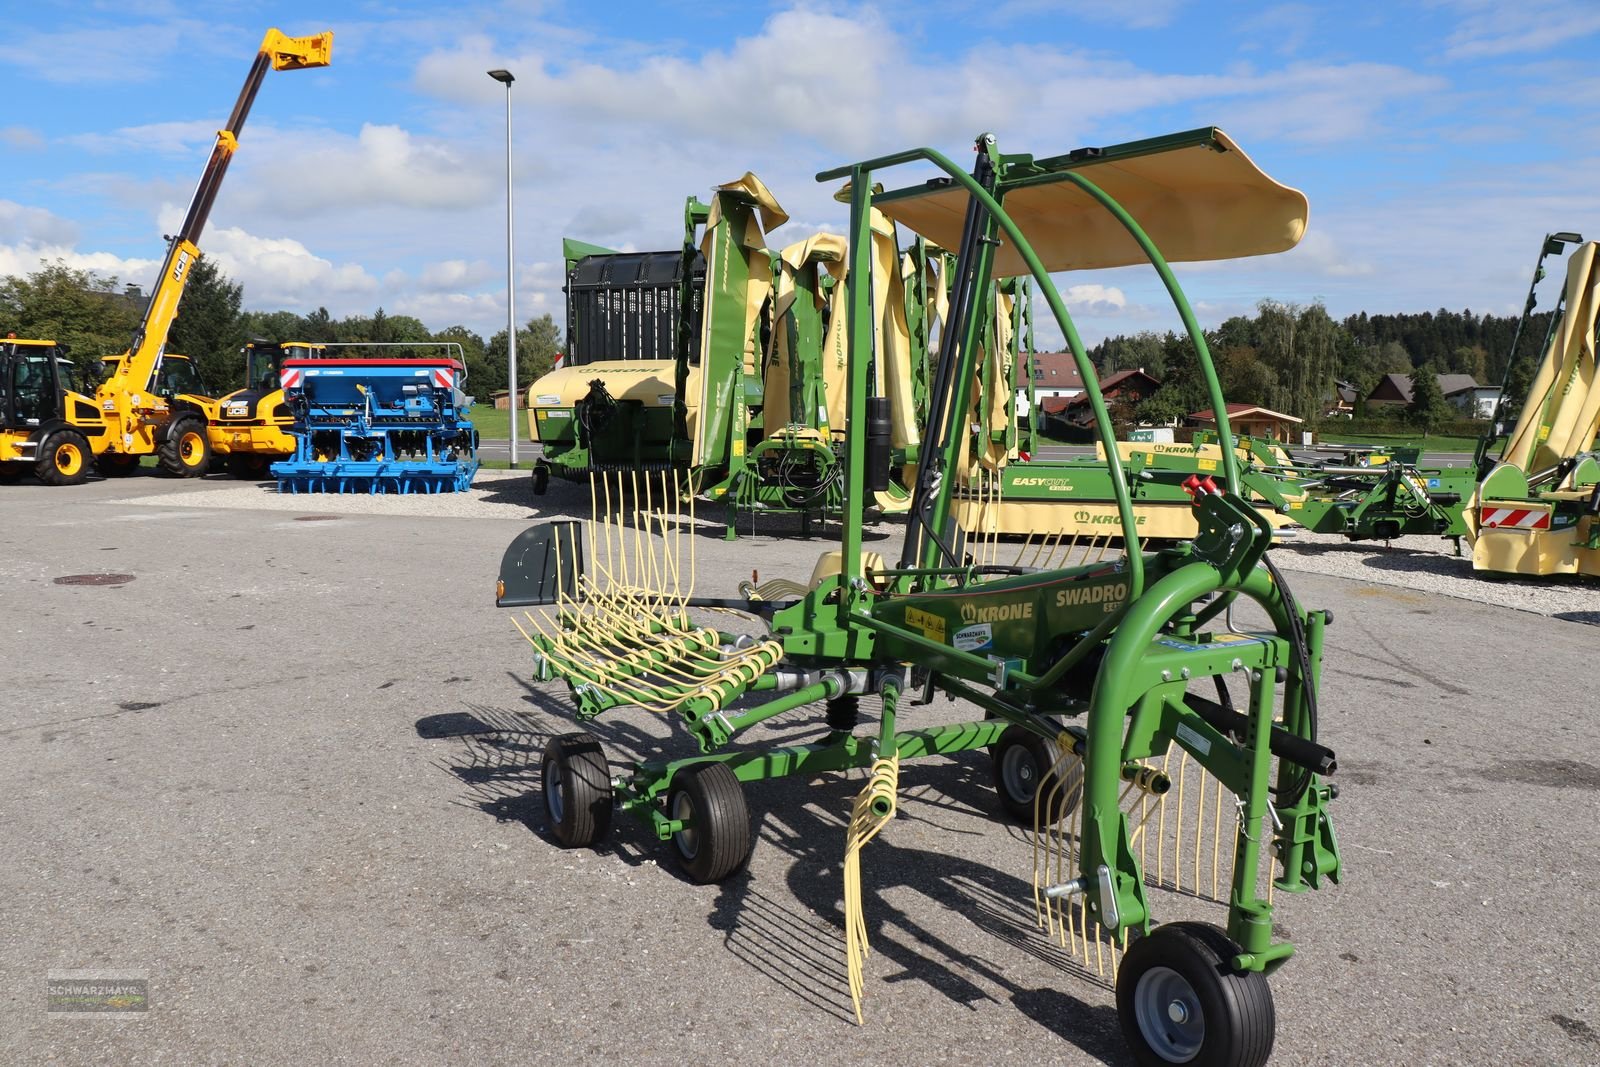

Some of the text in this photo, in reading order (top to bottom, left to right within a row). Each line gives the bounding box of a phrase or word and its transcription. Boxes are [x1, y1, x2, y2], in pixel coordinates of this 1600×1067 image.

[173, 250, 189, 282] JCB
[228, 406, 248, 416] JCB
[1090, 514, 1147, 525] KROE
[1056, 583, 1127, 607] SWADRO
[977, 602, 1033, 624] KRONE
